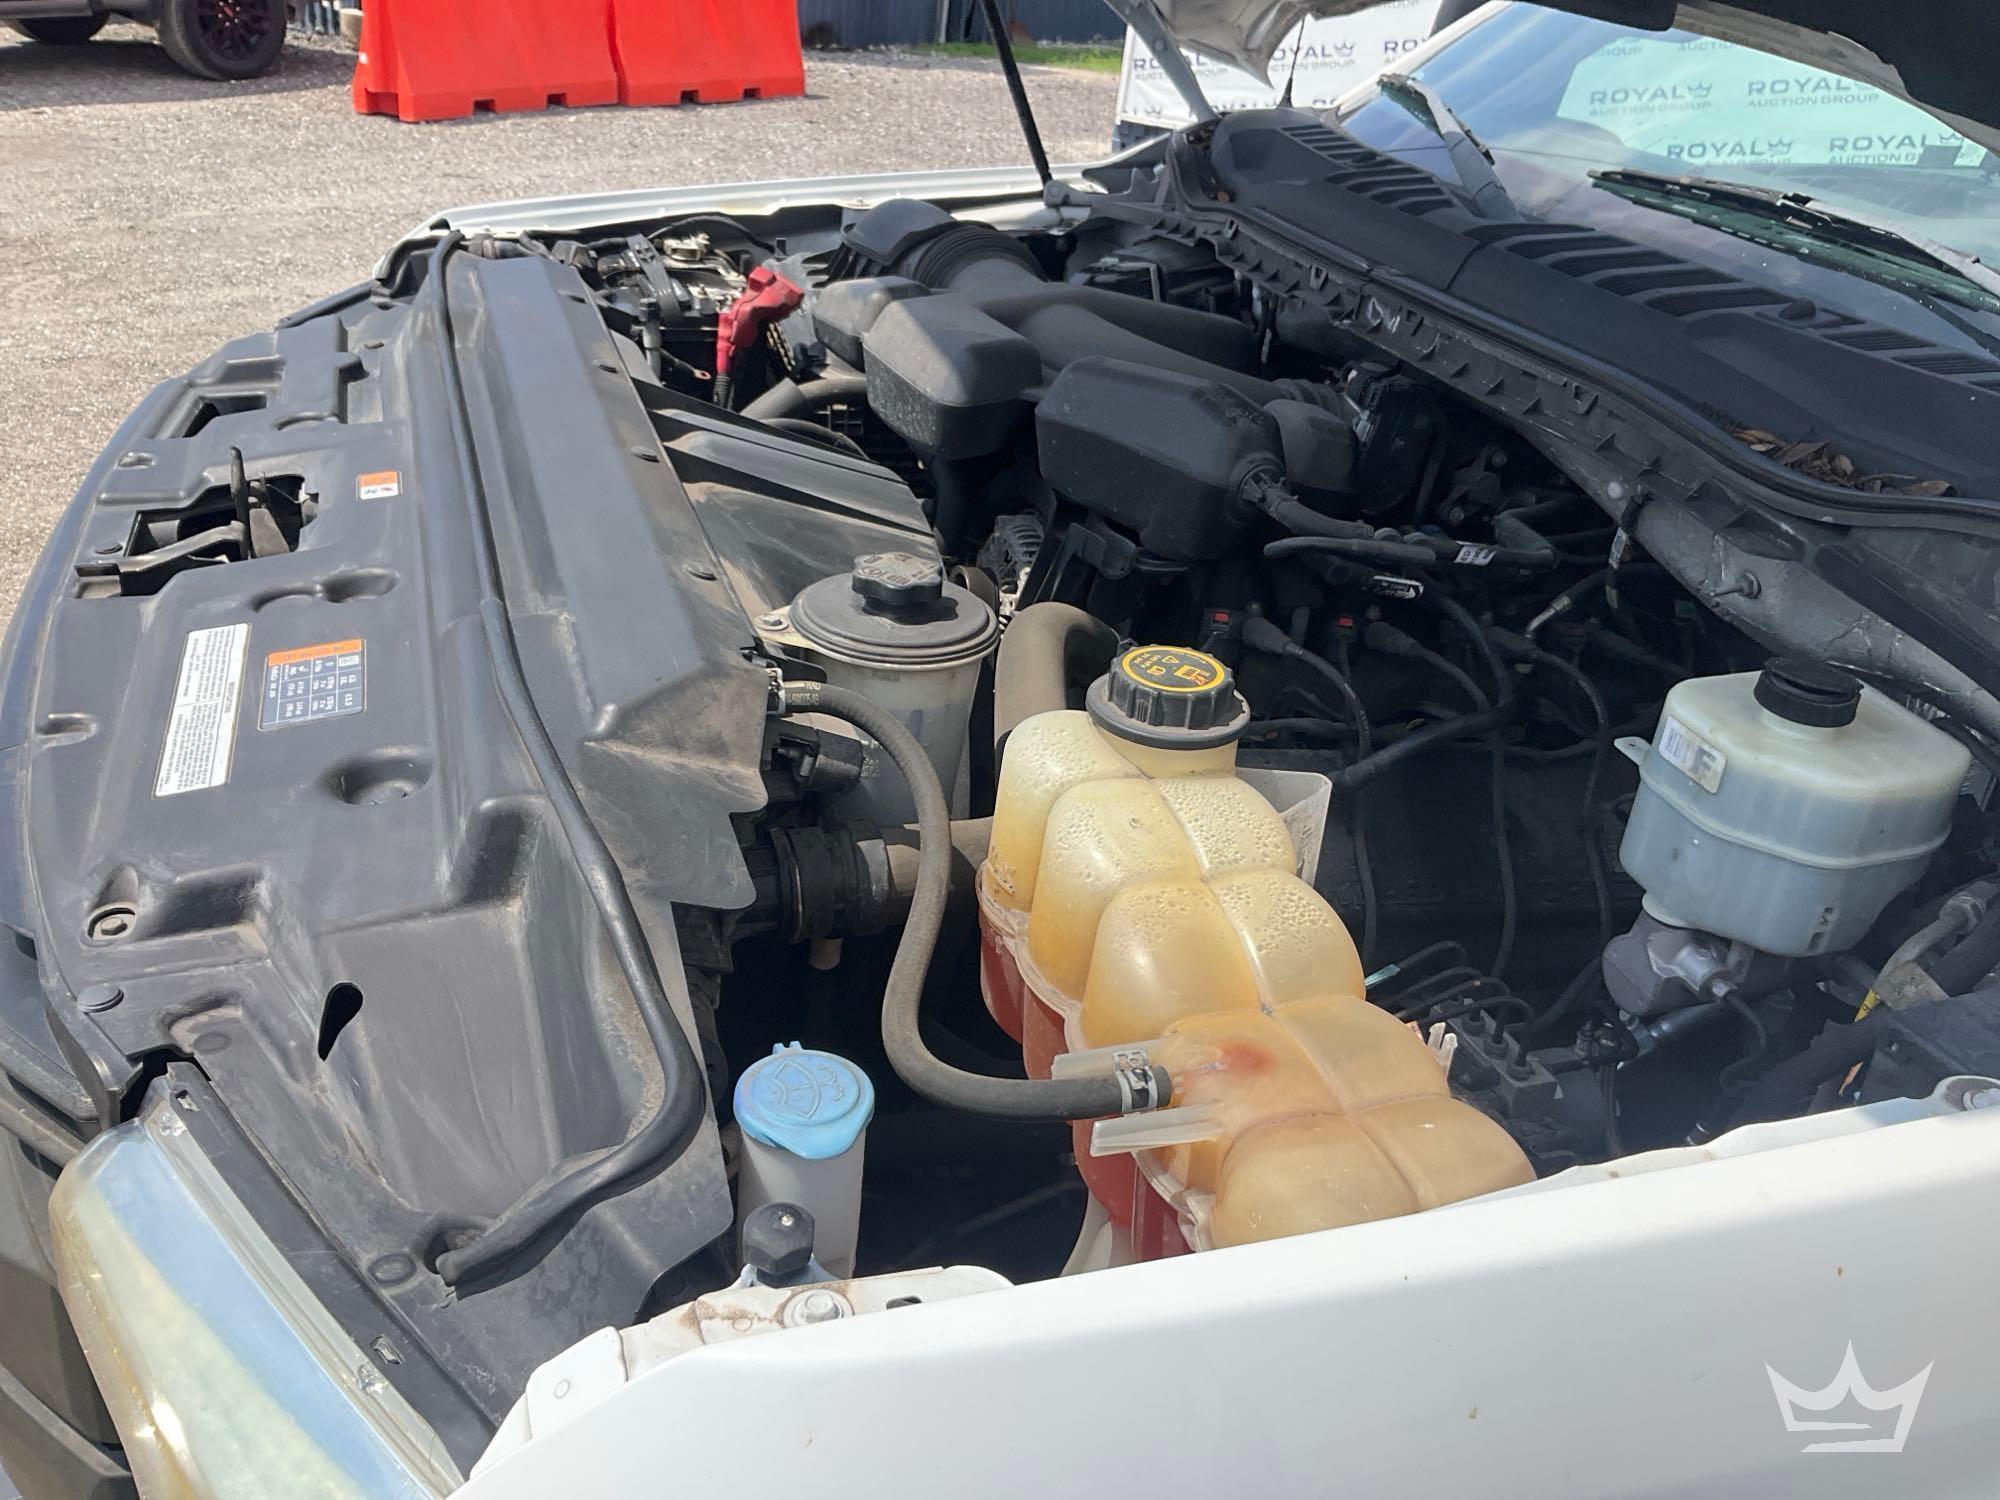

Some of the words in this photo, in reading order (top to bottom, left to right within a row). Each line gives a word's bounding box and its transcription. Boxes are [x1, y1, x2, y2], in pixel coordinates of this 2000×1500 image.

[1271, 45, 1333, 61] OYAL
[1589, 85, 1686, 105] ROYAL
[1748, 78, 1851, 96] ROYAL
[1747, 96, 1818, 107] AUCTION
[1820, 93, 1880, 105] GROUP
[1589, 104, 1656, 117] AUCTION
[1657, 101, 1712, 113] GROUP
[1667, 139, 1765, 159] ROYAL
